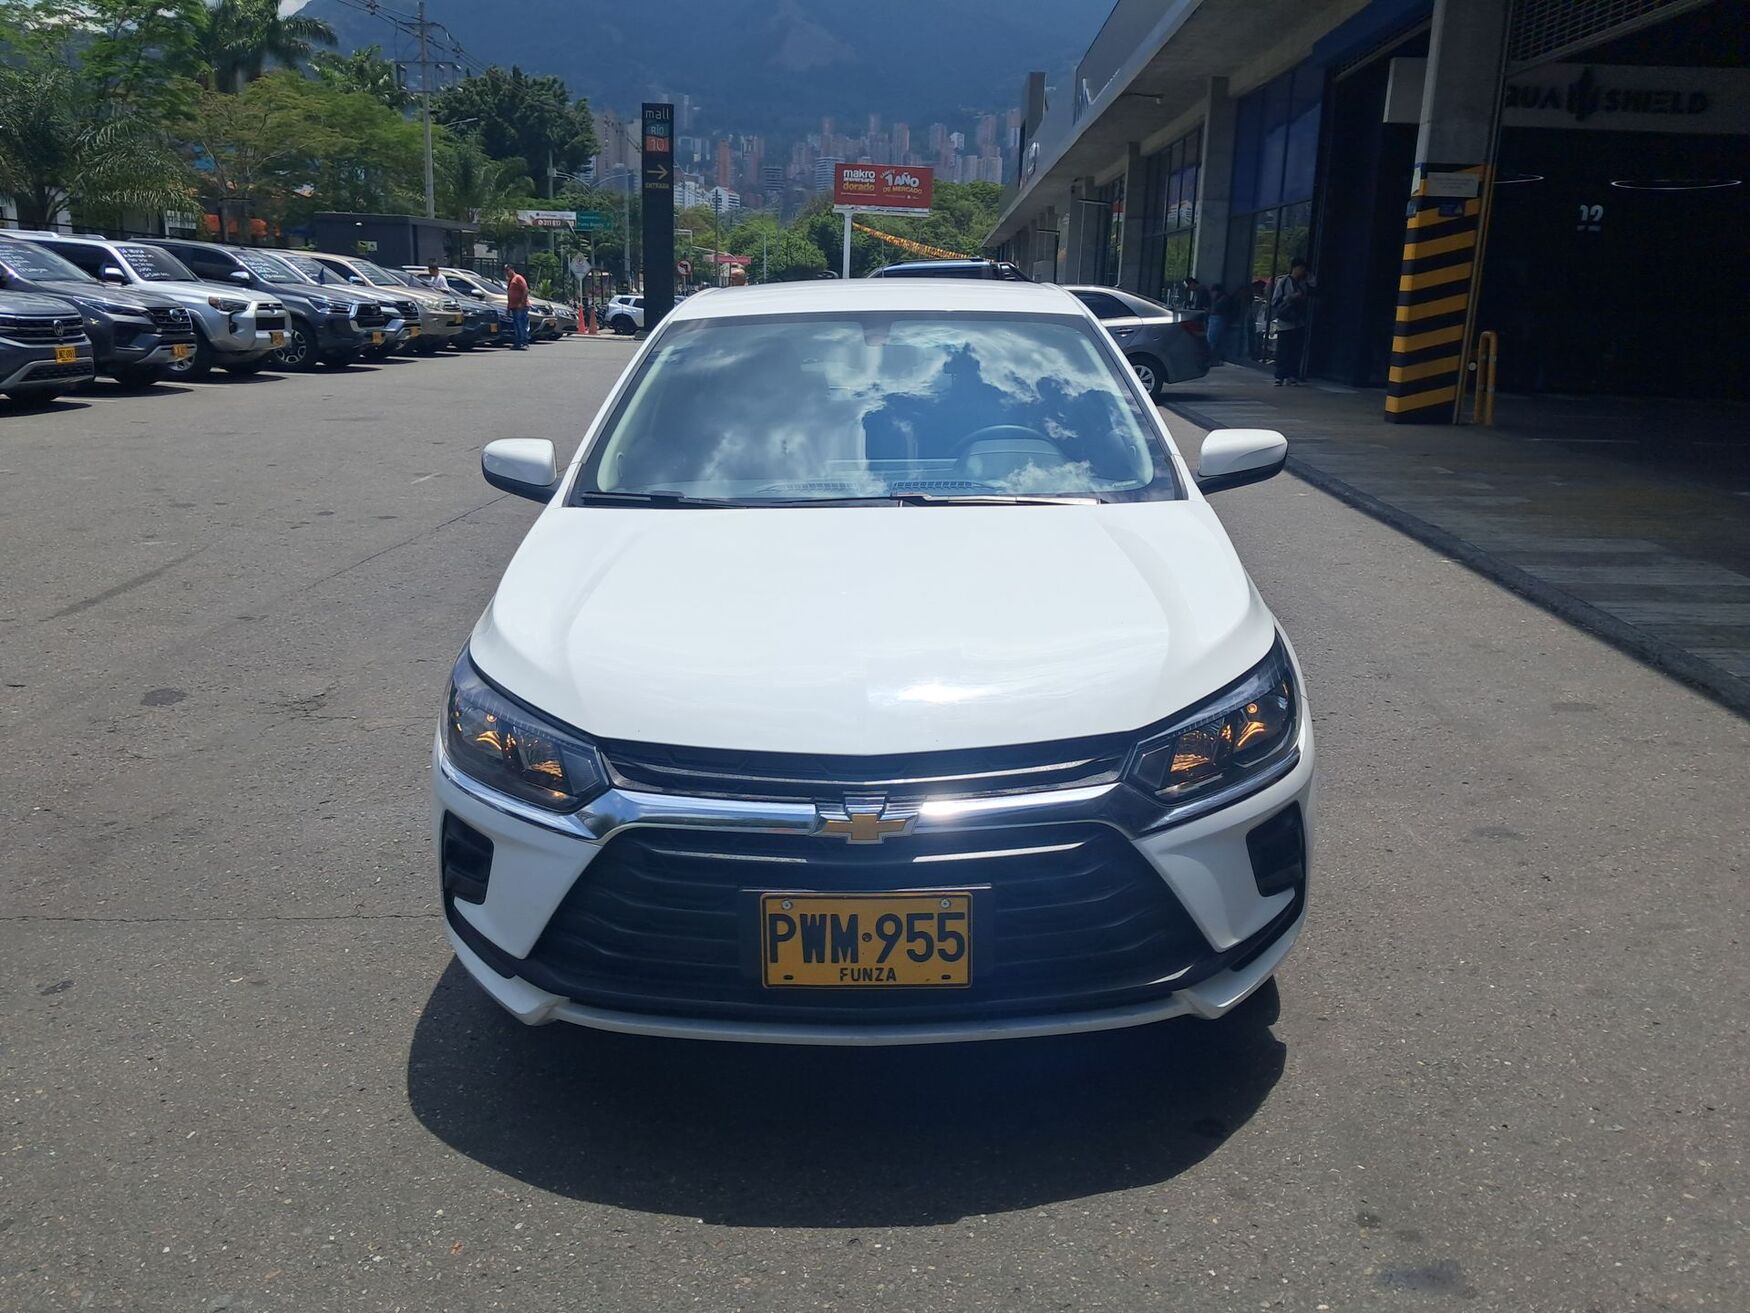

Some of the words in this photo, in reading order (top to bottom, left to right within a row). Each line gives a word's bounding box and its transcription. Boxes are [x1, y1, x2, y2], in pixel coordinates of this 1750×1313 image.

[1604, 88, 1709, 114] SHIELD
[645, 107, 669, 120] mall
[843, 169, 875, 178] makro
[884, 173, 893, 186] 1
[894, 172, 920, 187] AÑO
[843, 182, 875, 191] dorado
[840, 967, 897, 982] FUNZA
